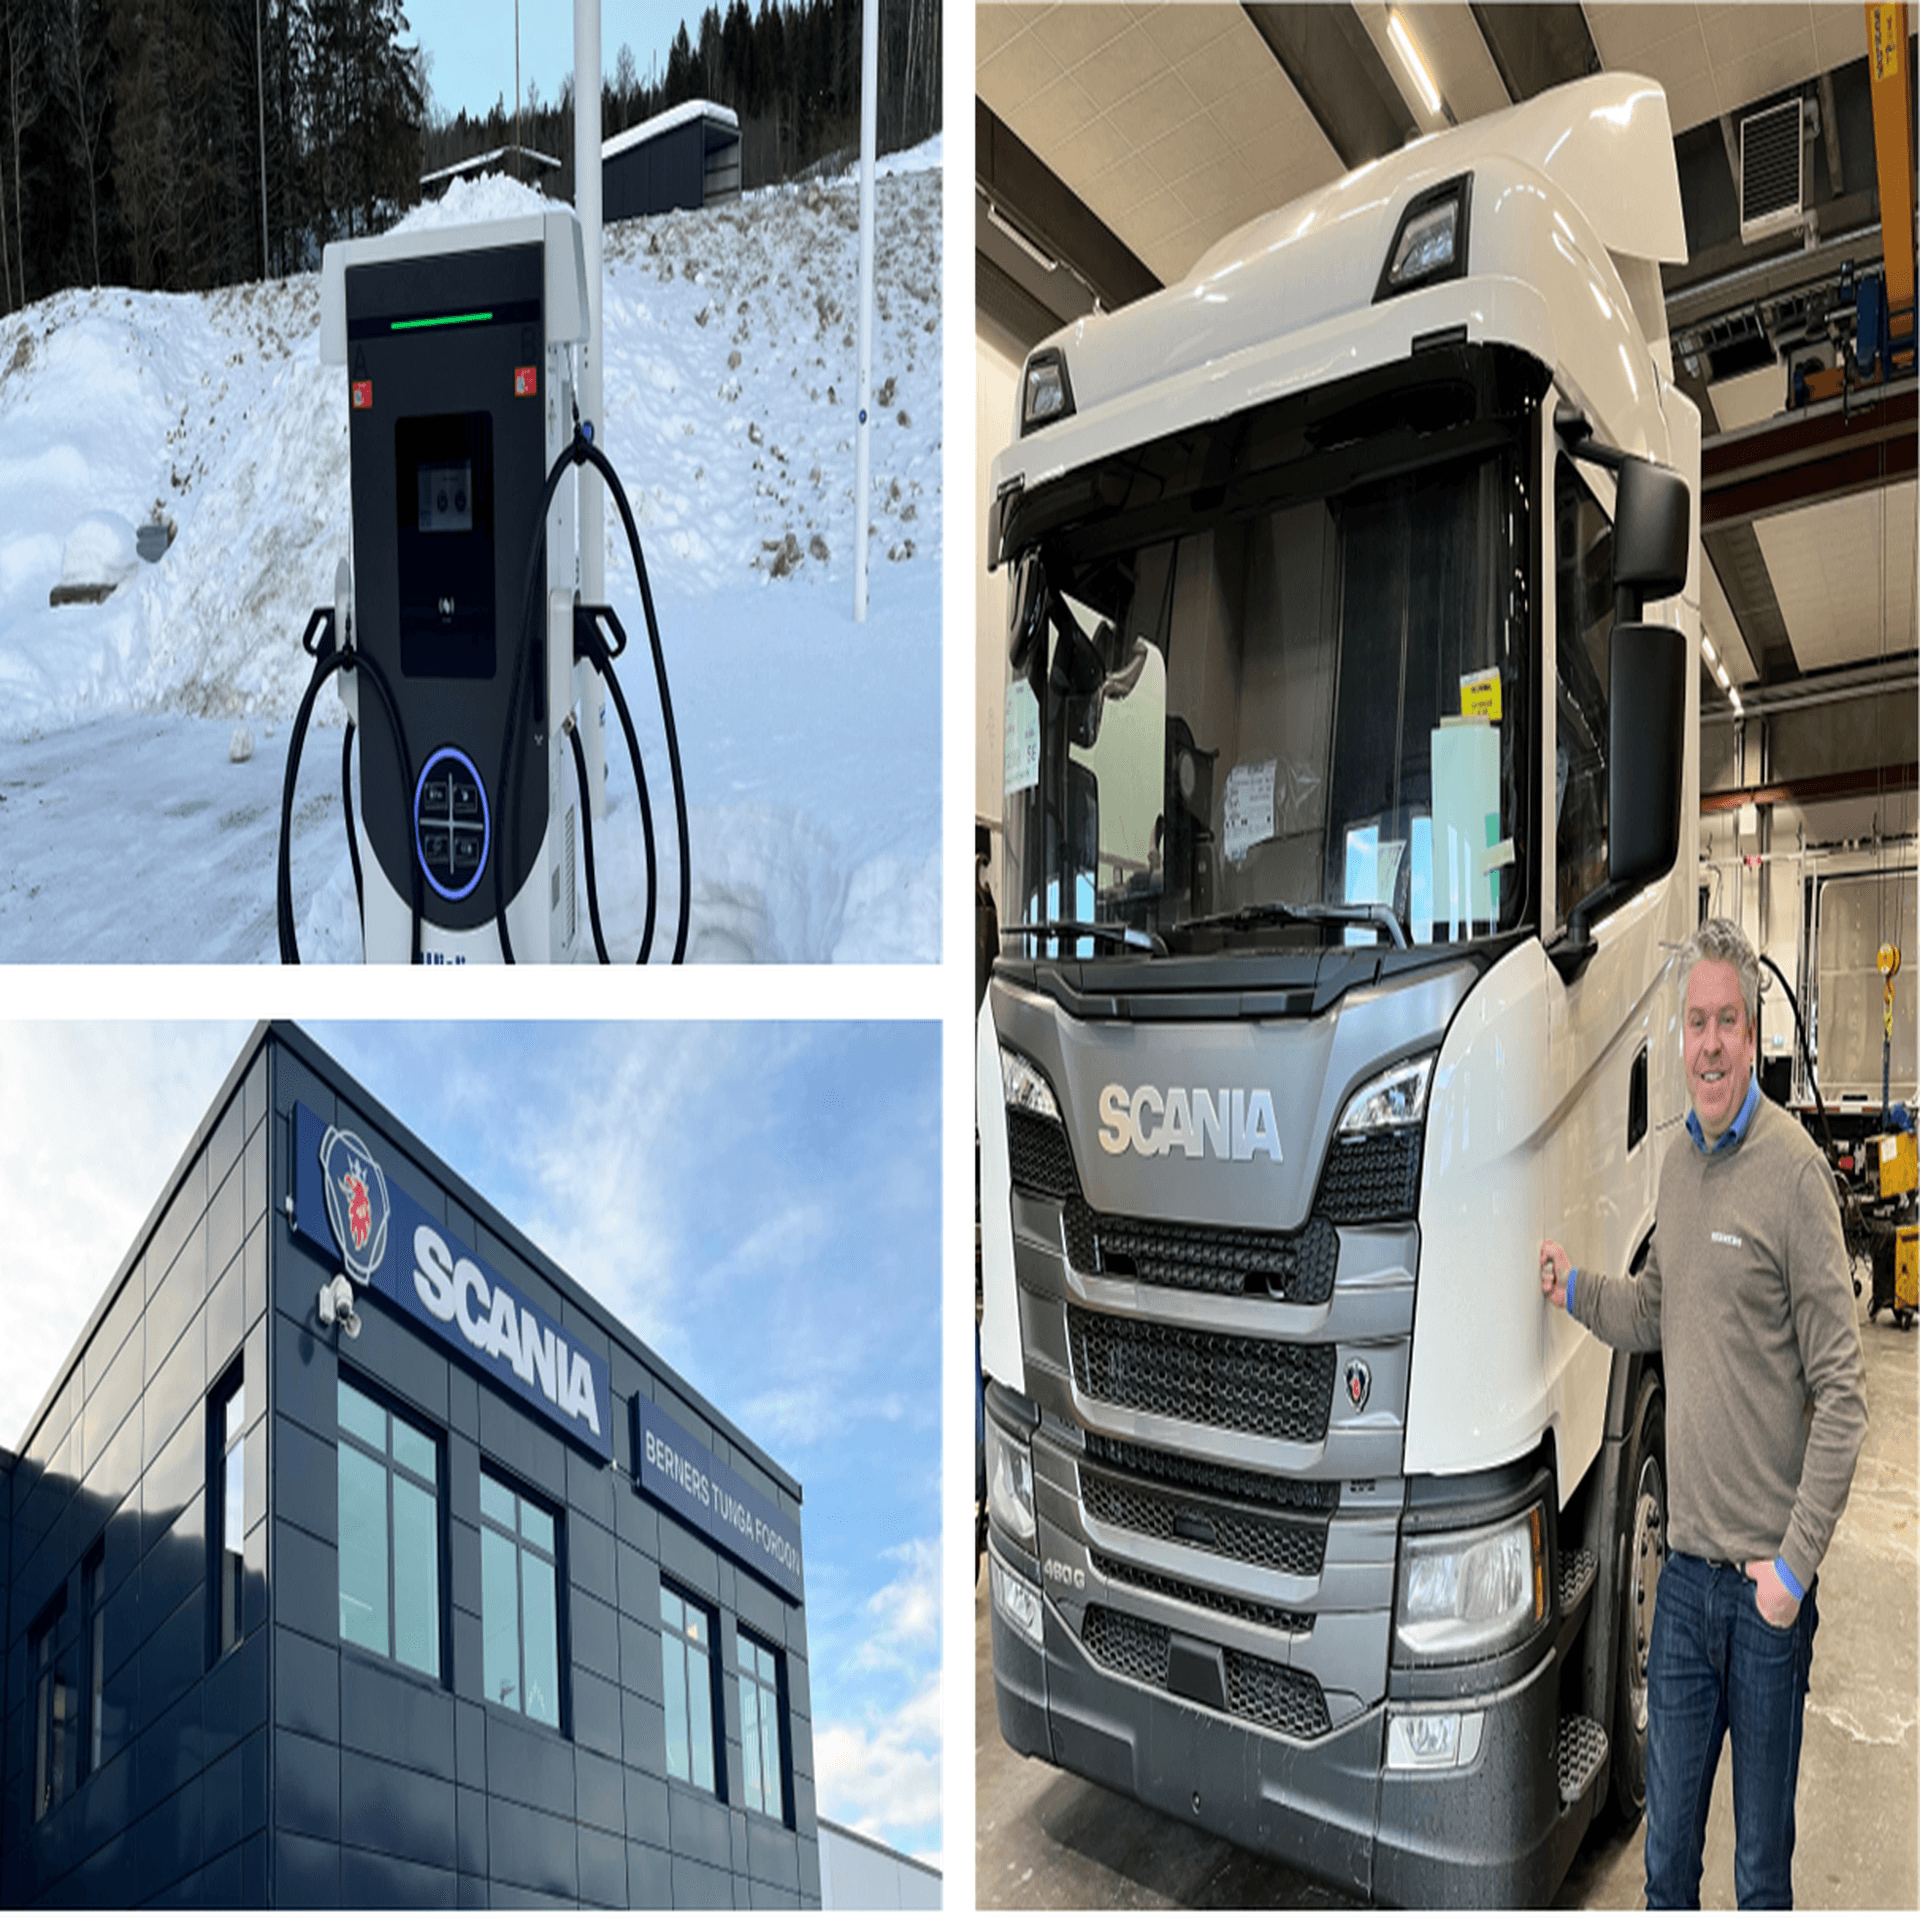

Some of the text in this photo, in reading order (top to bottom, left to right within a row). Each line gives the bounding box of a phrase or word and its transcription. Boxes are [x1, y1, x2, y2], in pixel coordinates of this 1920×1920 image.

[1098, 1083, 1283, 1162] SCANIA
[413, 1224, 600, 1438] SCANIA
[646, 1429, 801, 1576] BERNERS TUNGA FORDON
